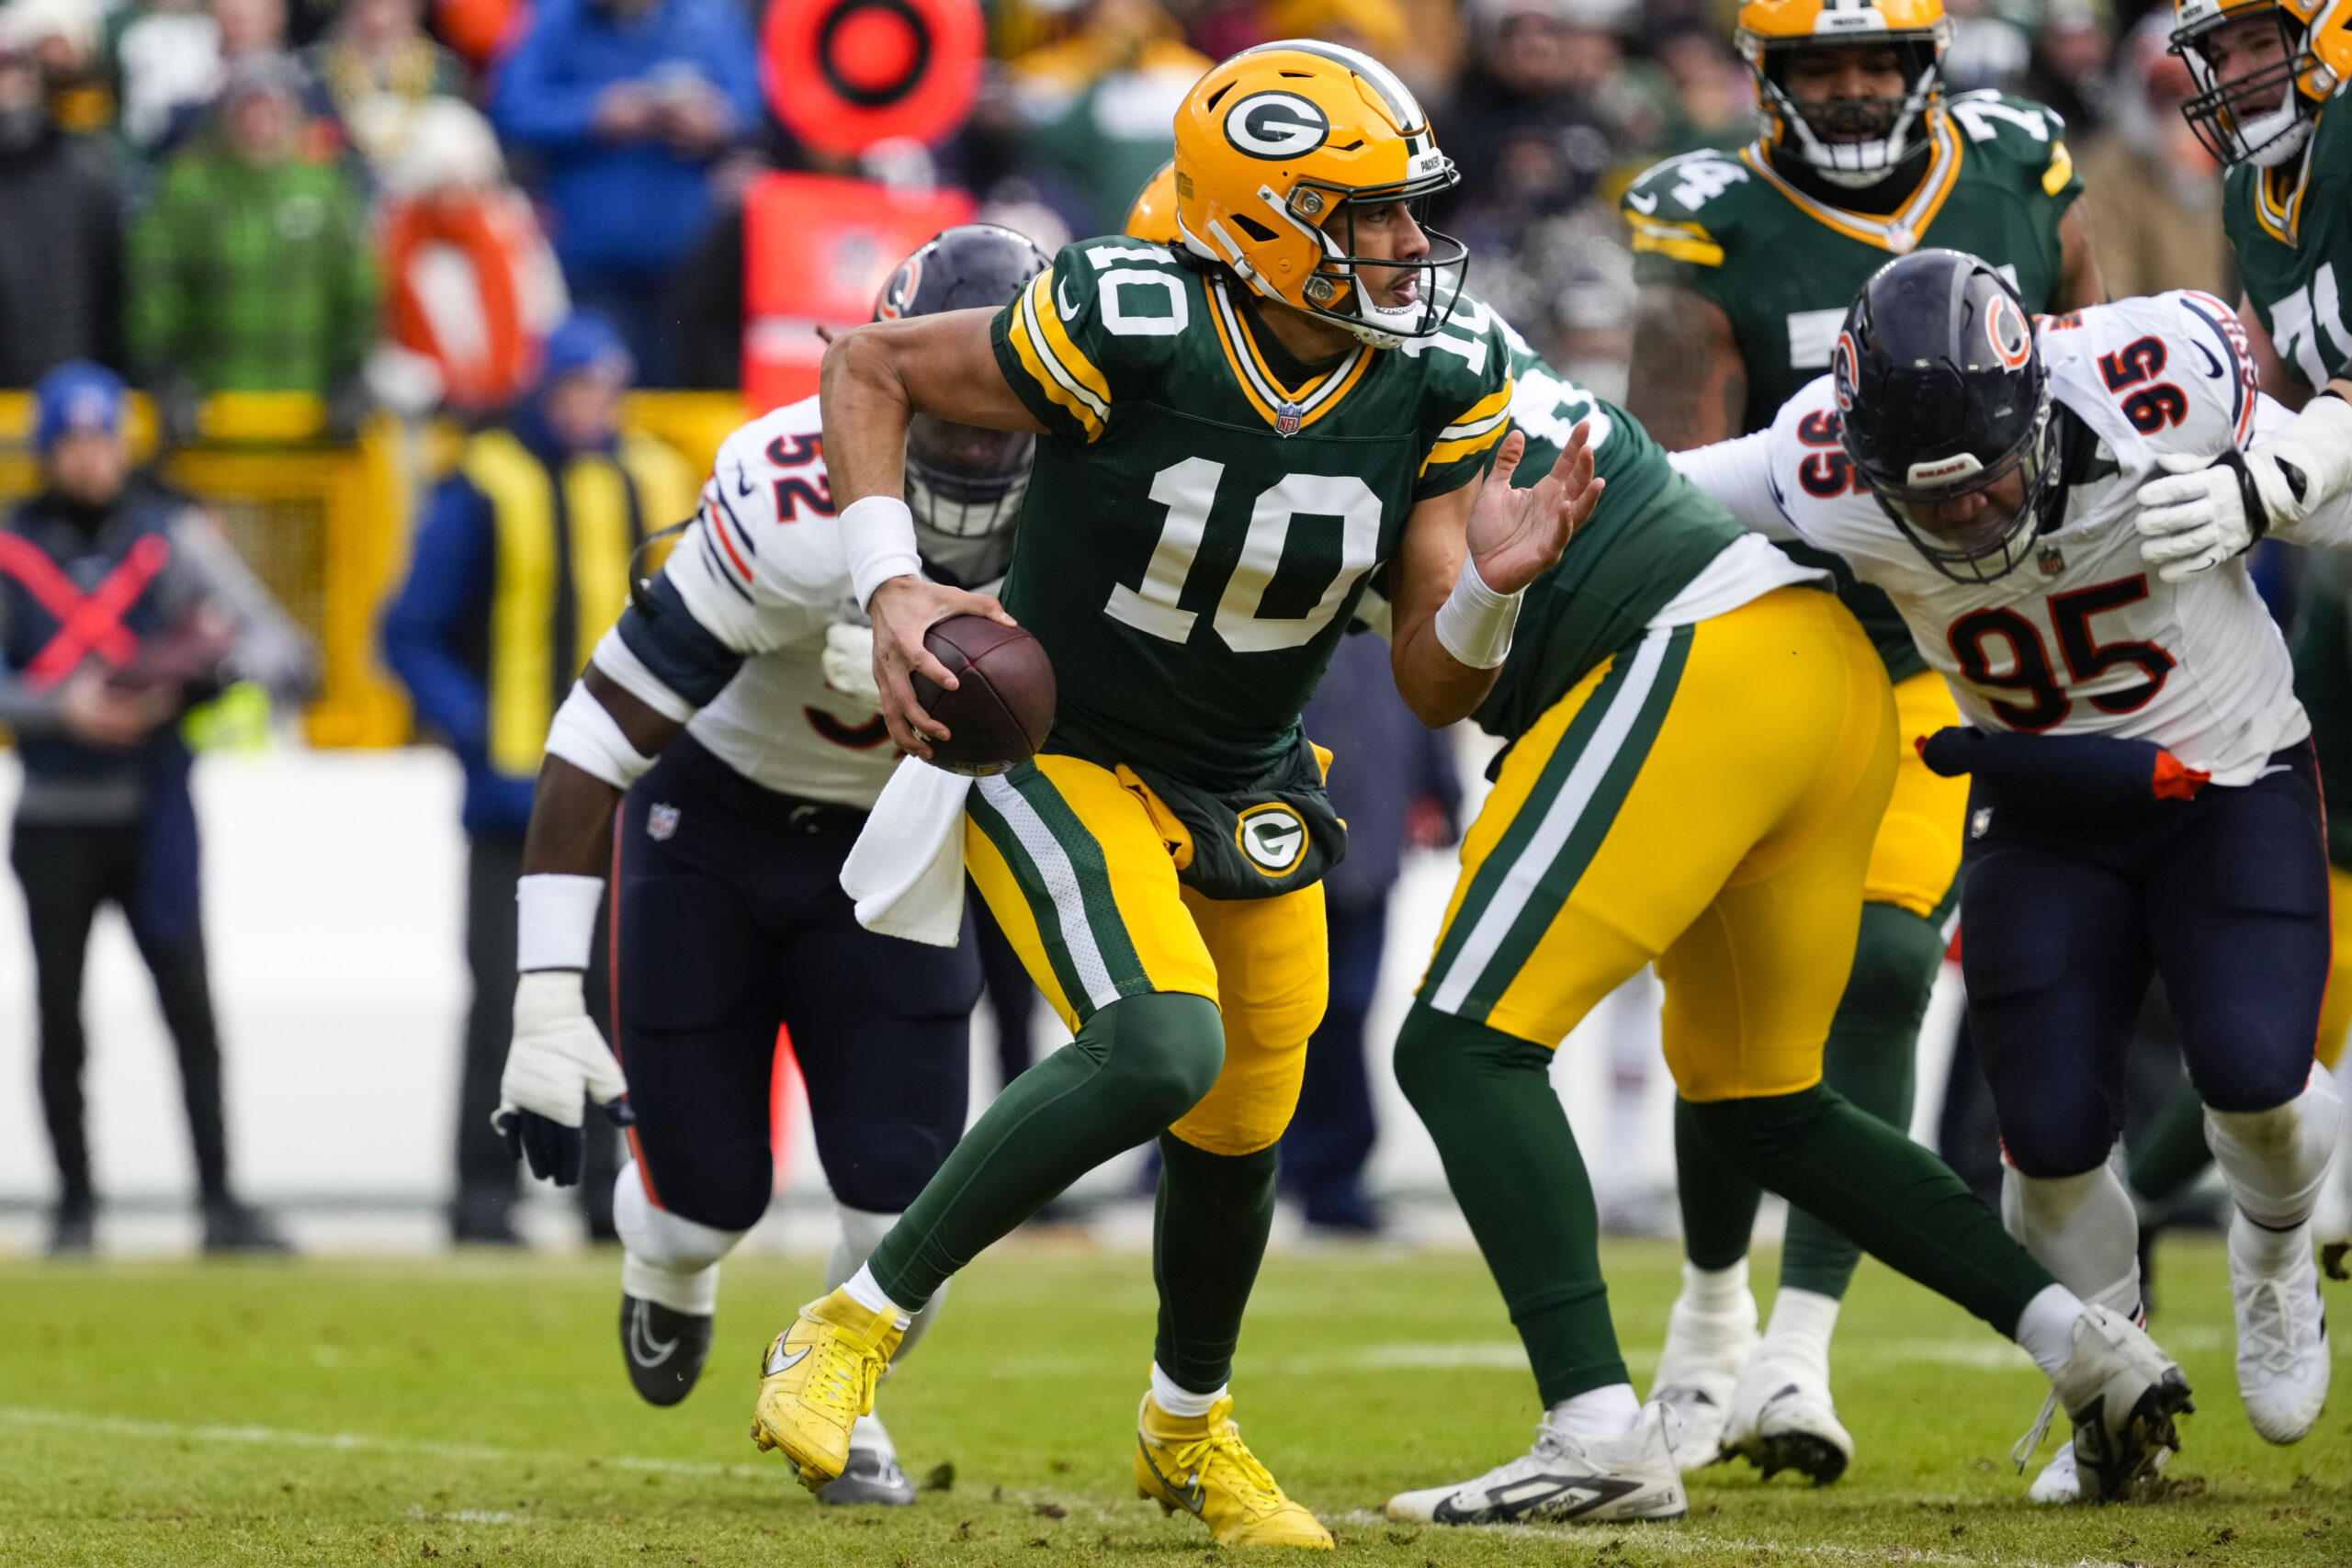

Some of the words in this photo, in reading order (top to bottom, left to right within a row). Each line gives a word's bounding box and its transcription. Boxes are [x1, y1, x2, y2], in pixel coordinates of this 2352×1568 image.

[1227, 95, 1324, 155] G
[1085, 244, 1189, 336] 10
[1278, 417, 1296, 432] NFL
[2097, 335, 2188, 435] 95
[764, 432, 838, 524] 52
[1916, 462, 1966, 478] BEARS
[1104, 457, 1383, 653] 10
[1948, 573, 2177, 733] 95
[1244, 812, 1302, 868] G
